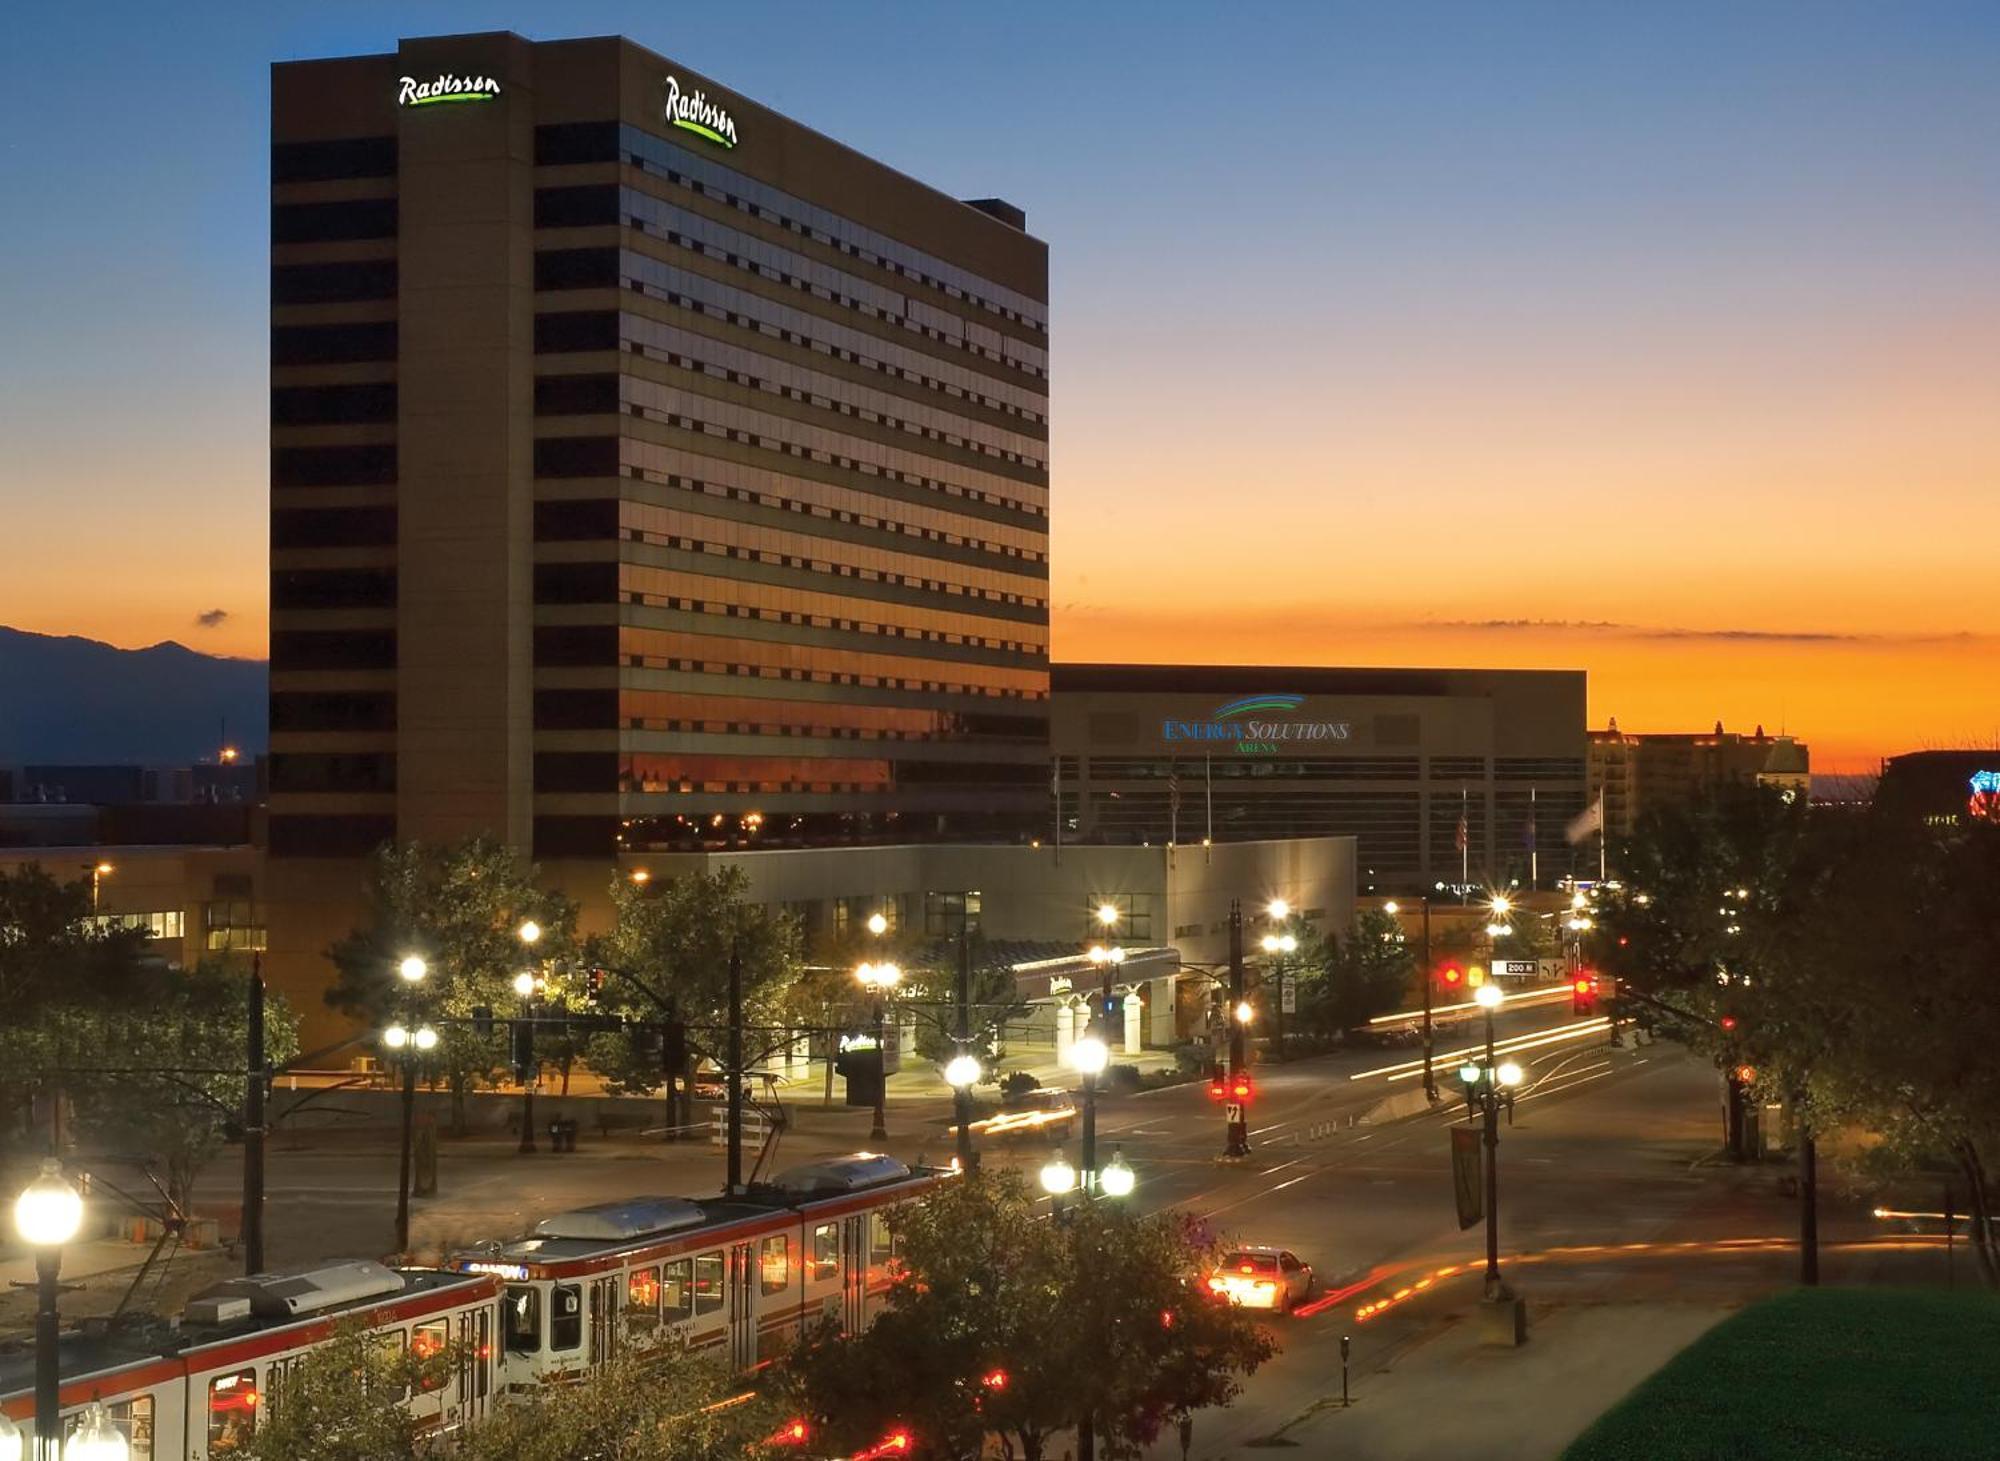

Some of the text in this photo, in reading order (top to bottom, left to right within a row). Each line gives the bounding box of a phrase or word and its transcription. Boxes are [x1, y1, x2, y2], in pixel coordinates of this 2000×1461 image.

[398, 73, 501, 106] Radisson
[665, 74, 738, 145] Radisson
[1237, 742, 1278, 753] ARENA
[1508, 963, 1524, 973] 200
